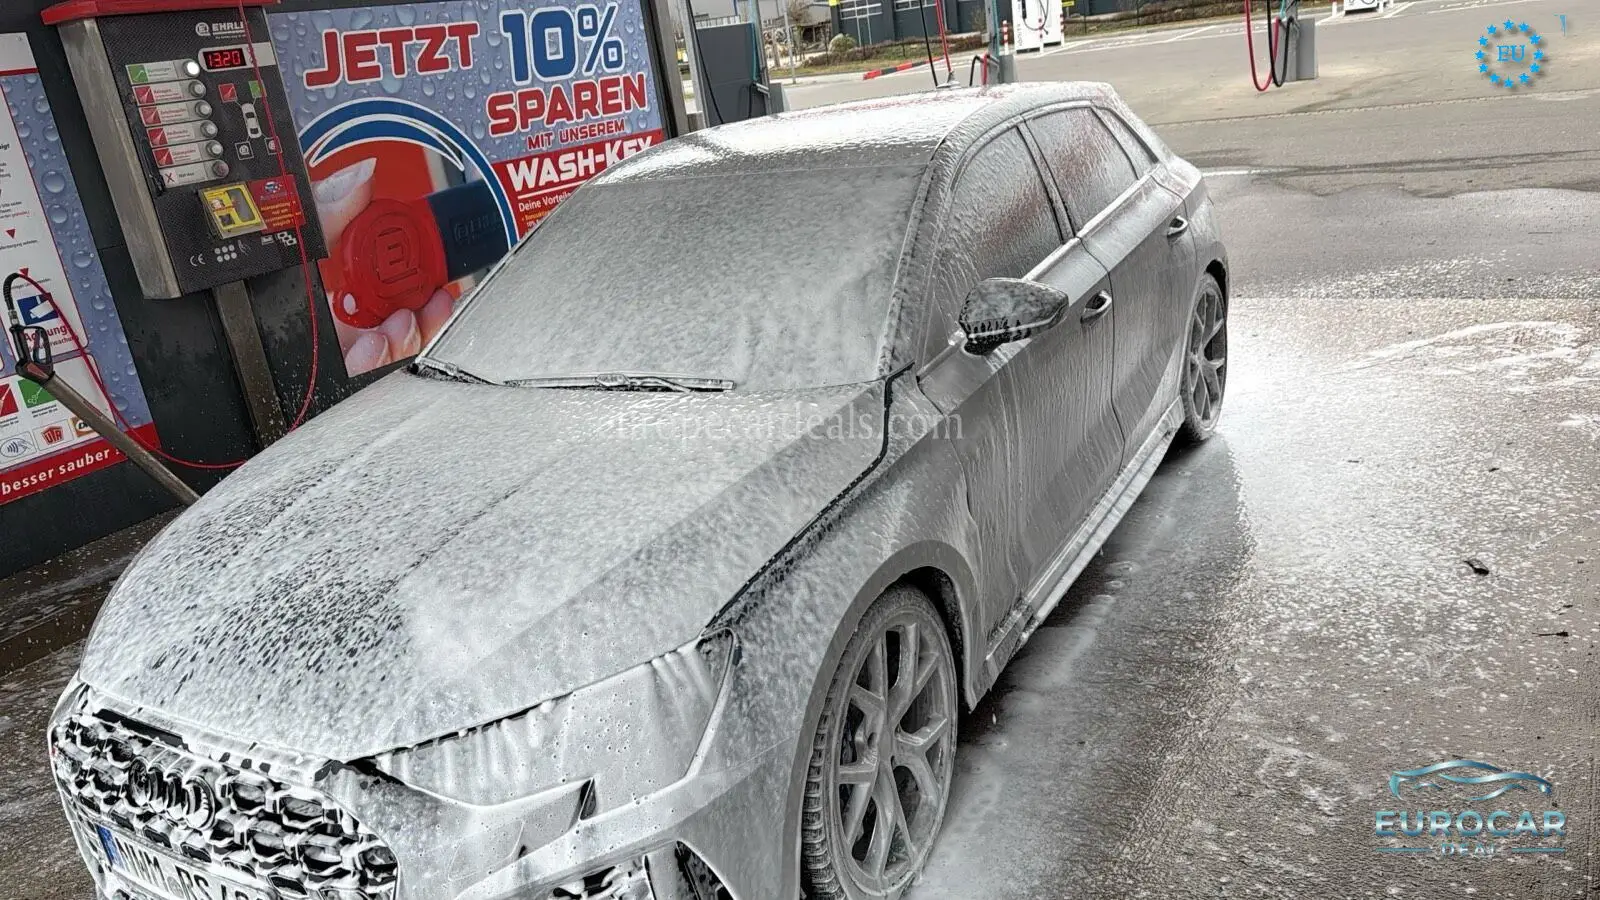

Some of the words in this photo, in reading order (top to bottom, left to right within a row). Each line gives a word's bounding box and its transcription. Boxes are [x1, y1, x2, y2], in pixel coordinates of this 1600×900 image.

[304, 22, 480, 89] JETZT
[500, 3, 625, 86] 10%
[487, 73, 648, 136] SPAREN
[527, 132, 554, 150] MIT
[559, 118, 625, 144] UNSEREM
[518, 199, 541, 212] Deine
[1, 467, 55, 496] besser
[59, 448, 111, 475] sauber
